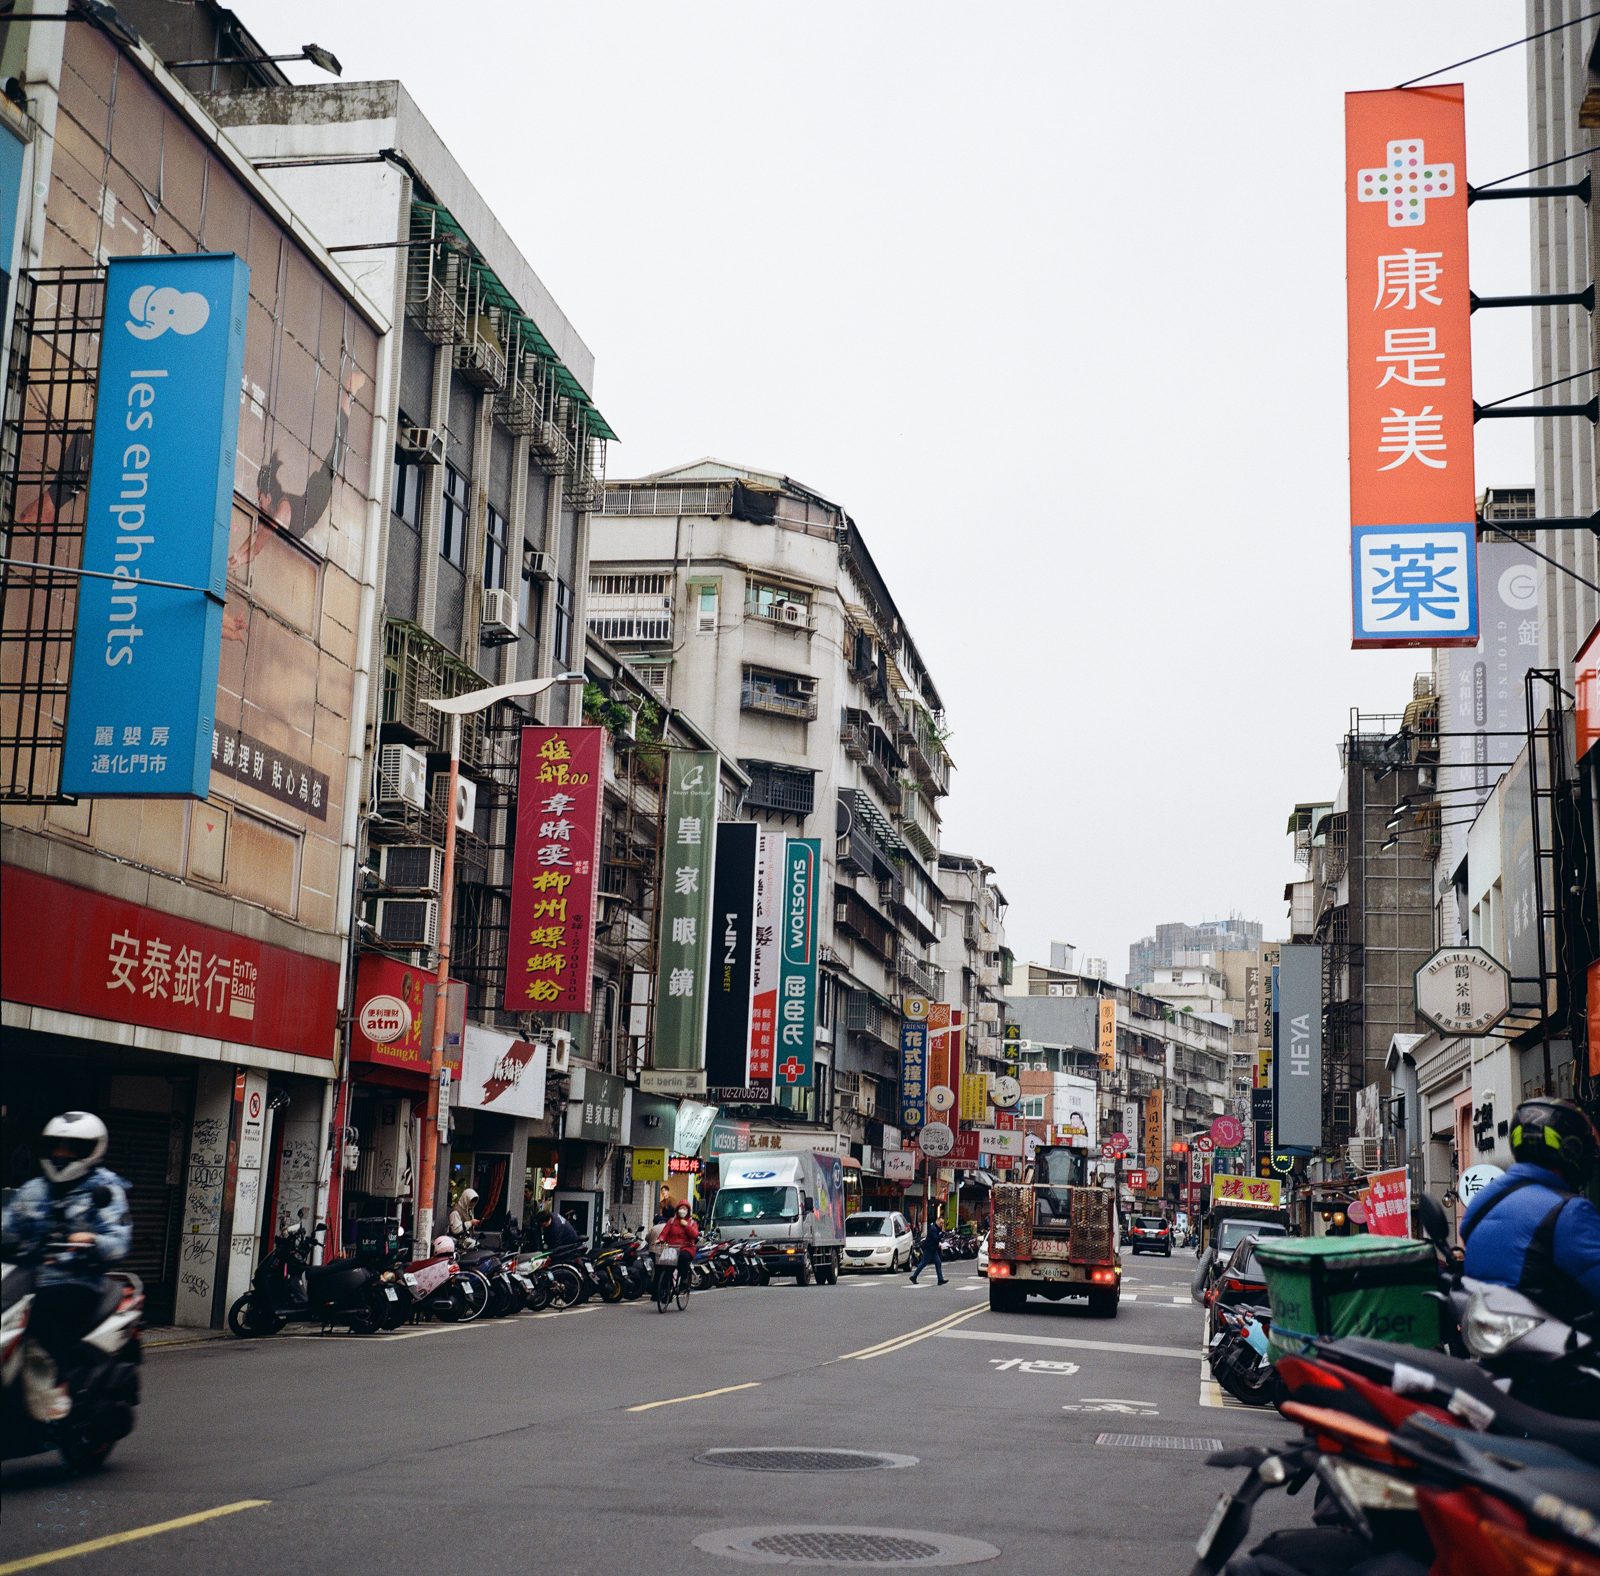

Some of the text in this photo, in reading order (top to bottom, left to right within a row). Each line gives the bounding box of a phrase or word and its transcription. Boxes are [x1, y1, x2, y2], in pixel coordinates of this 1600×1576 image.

[1373, 248, 1449, 473] 康是美
[105, 369, 168, 667] les enphants
[94, 726, 170, 747] 麗嬰房
[91, 753, 168, 774] 通化門市
[211, 729, 322, 808] 真誠理財 貼心為您
[537, 792, 576, 867] 韋晴雯
[668, 816, 702, 998] 皇家眼鏡
[790, 859, 807, 949] watsons
[524, 870, 572, 1002] 柳州螺螄粉
[107, 929, 231, 1014] 安泰銀行
[232, 958, 258, 982] EnTie
[723, 965, 732, 993] SWEET
[230, 977, 256, 1000] Bank
[1454, 964, 1472, 1017] 鶴茶樓
[367, 1009, 399, 1018] 便利理財
[782, 975, 807, 1046] 屈臣氏
[912, 1001, 922, 1013] 9
[367, 1018, 399, 1030] atm
[1290, 1013, 1310, 1076] HEYA
[903, 1031, 922, 1099] 花式撞球
[657, 1075, 683, 1087] berlin
[721, 1086, 769, 1100] 02-27005729
[936, 1094, 945, 1104] 9
[585, 1103, 620, 1129] 皇家眼鏡
[905, 1111, 918, 1121] B1
[714, 1133, 736, 1149] watsons
[669, 1160, 700, 1172] 機配件
[1222, 1179, 1273, 1202] 烤鴨
